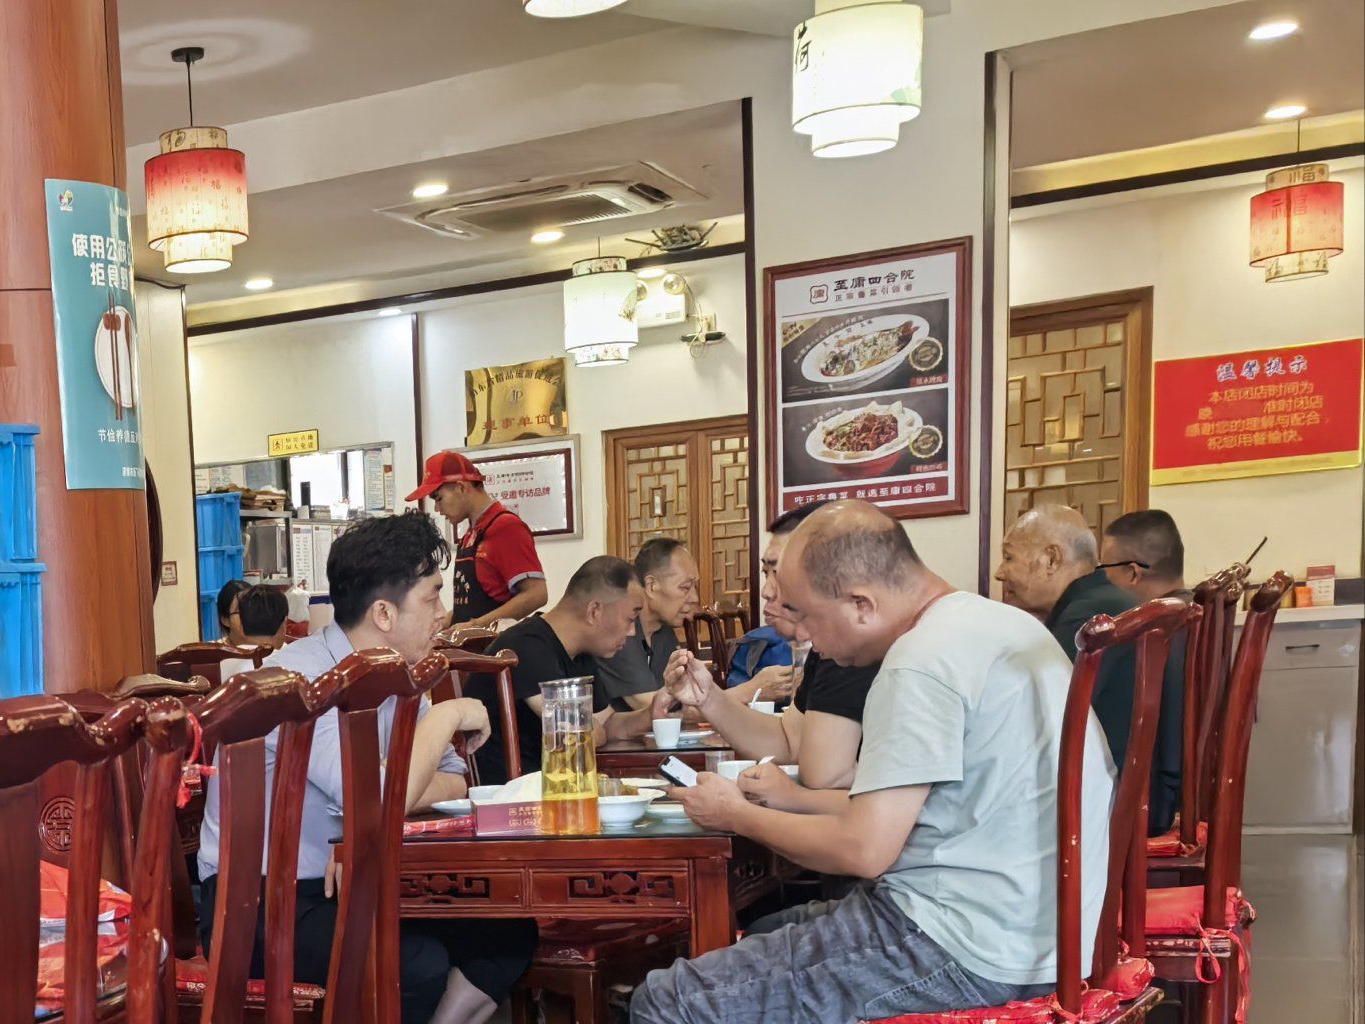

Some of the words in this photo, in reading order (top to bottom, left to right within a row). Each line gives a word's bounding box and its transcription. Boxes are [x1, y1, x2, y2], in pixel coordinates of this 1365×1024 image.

[833, 269, 915, 291] 至庸四合院
[1217, 355, 1307, 382] 温馨提示
